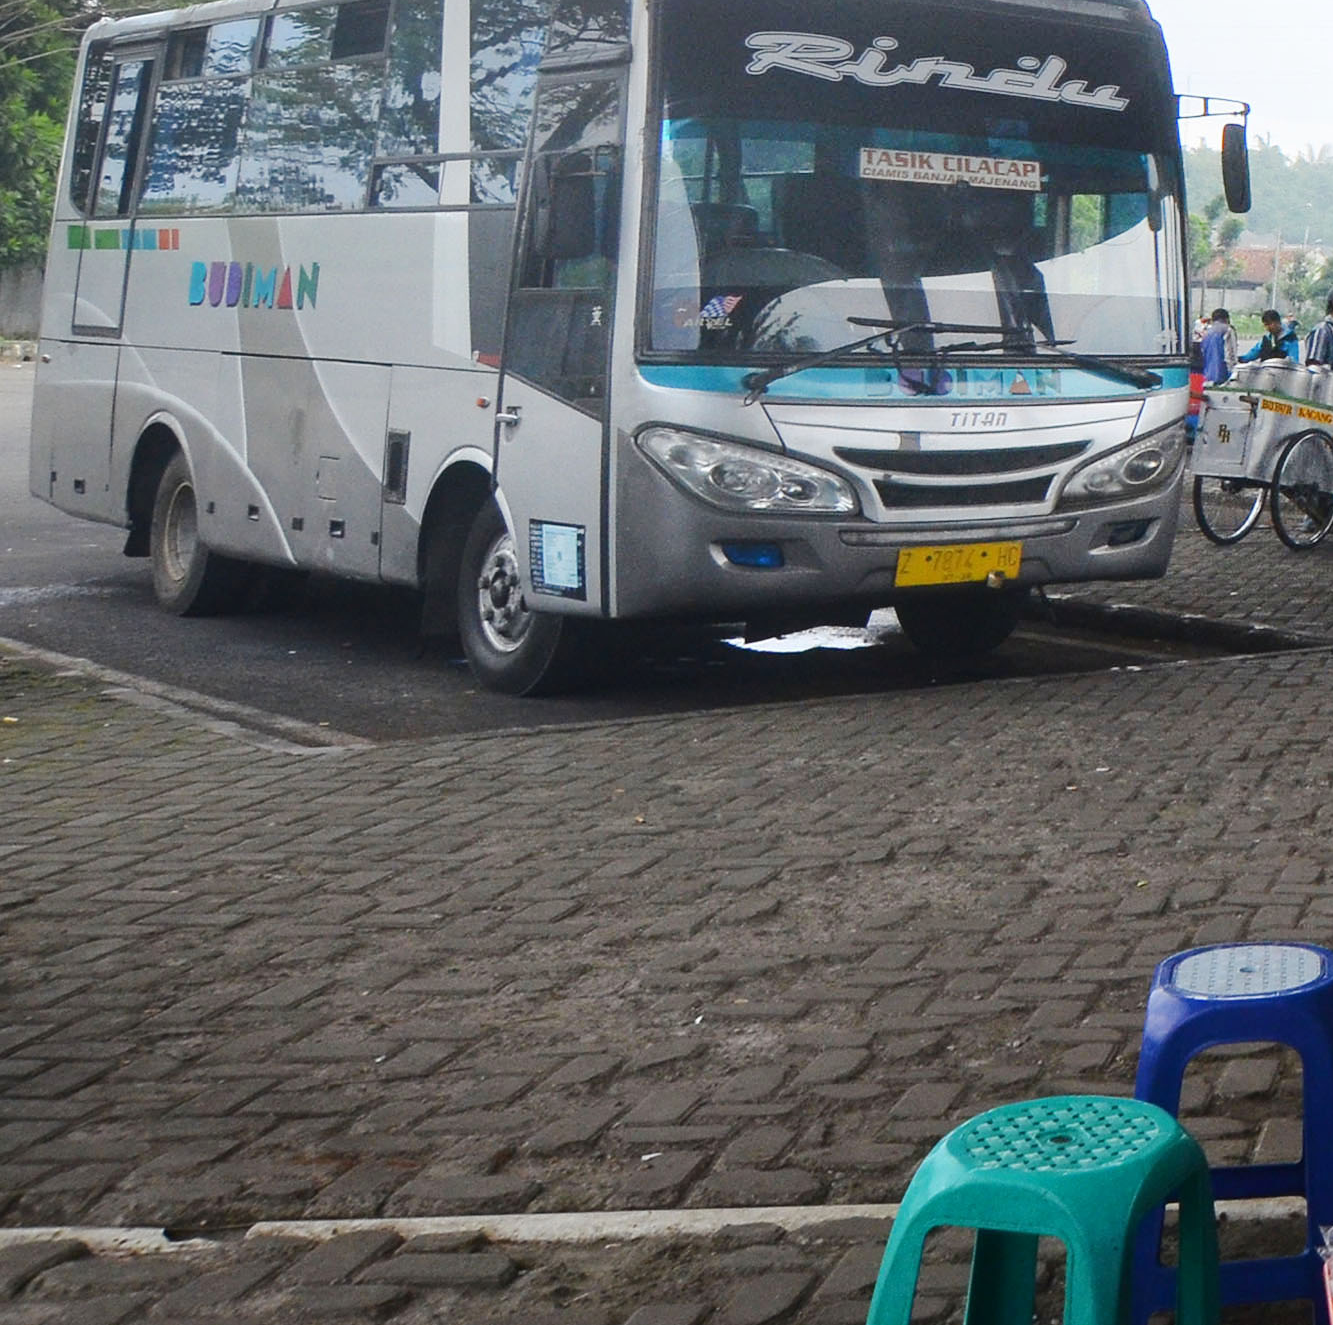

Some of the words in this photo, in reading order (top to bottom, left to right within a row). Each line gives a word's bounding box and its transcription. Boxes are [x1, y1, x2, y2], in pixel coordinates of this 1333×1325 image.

[745, 31, 1130, 112] Rindu
[862, 167, 909, 180] CIAMIS
[969, 177, 1038, 190] MAJENANG
[863, 149, 934, 170] TASIK
[943, 156, 1037, 178] CILACAP
[189, 261, 320, 310] BUDIMAN
